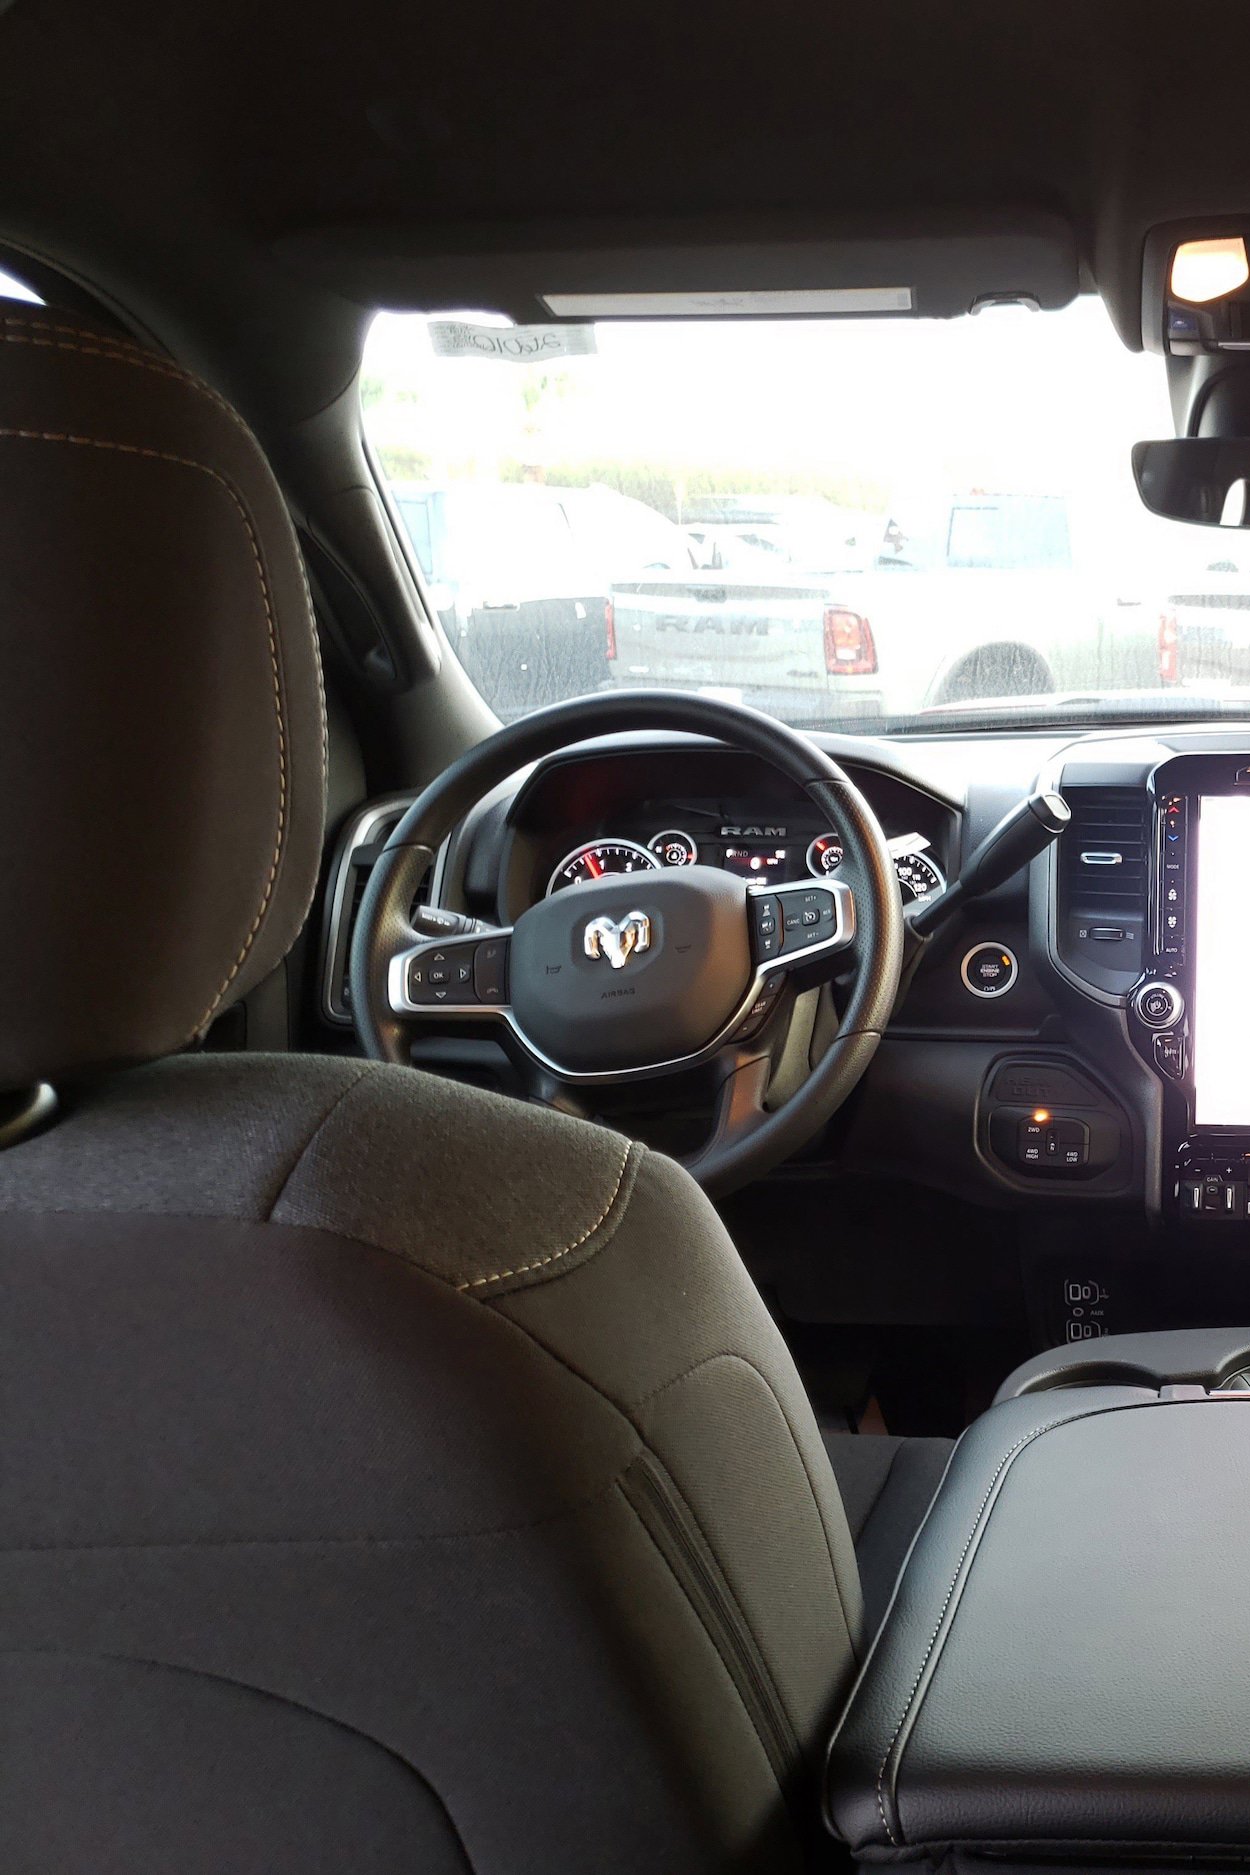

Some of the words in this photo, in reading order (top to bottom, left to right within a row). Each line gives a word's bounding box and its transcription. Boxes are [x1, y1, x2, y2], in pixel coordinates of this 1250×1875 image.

[656, 616, 769, 635] RAM
[720, 826, 787, 836] RAM
[898, 867, 912, 876] 100
[913, 882, 927, 892] 120
[601, 988, 636, 999] AIRBAG
